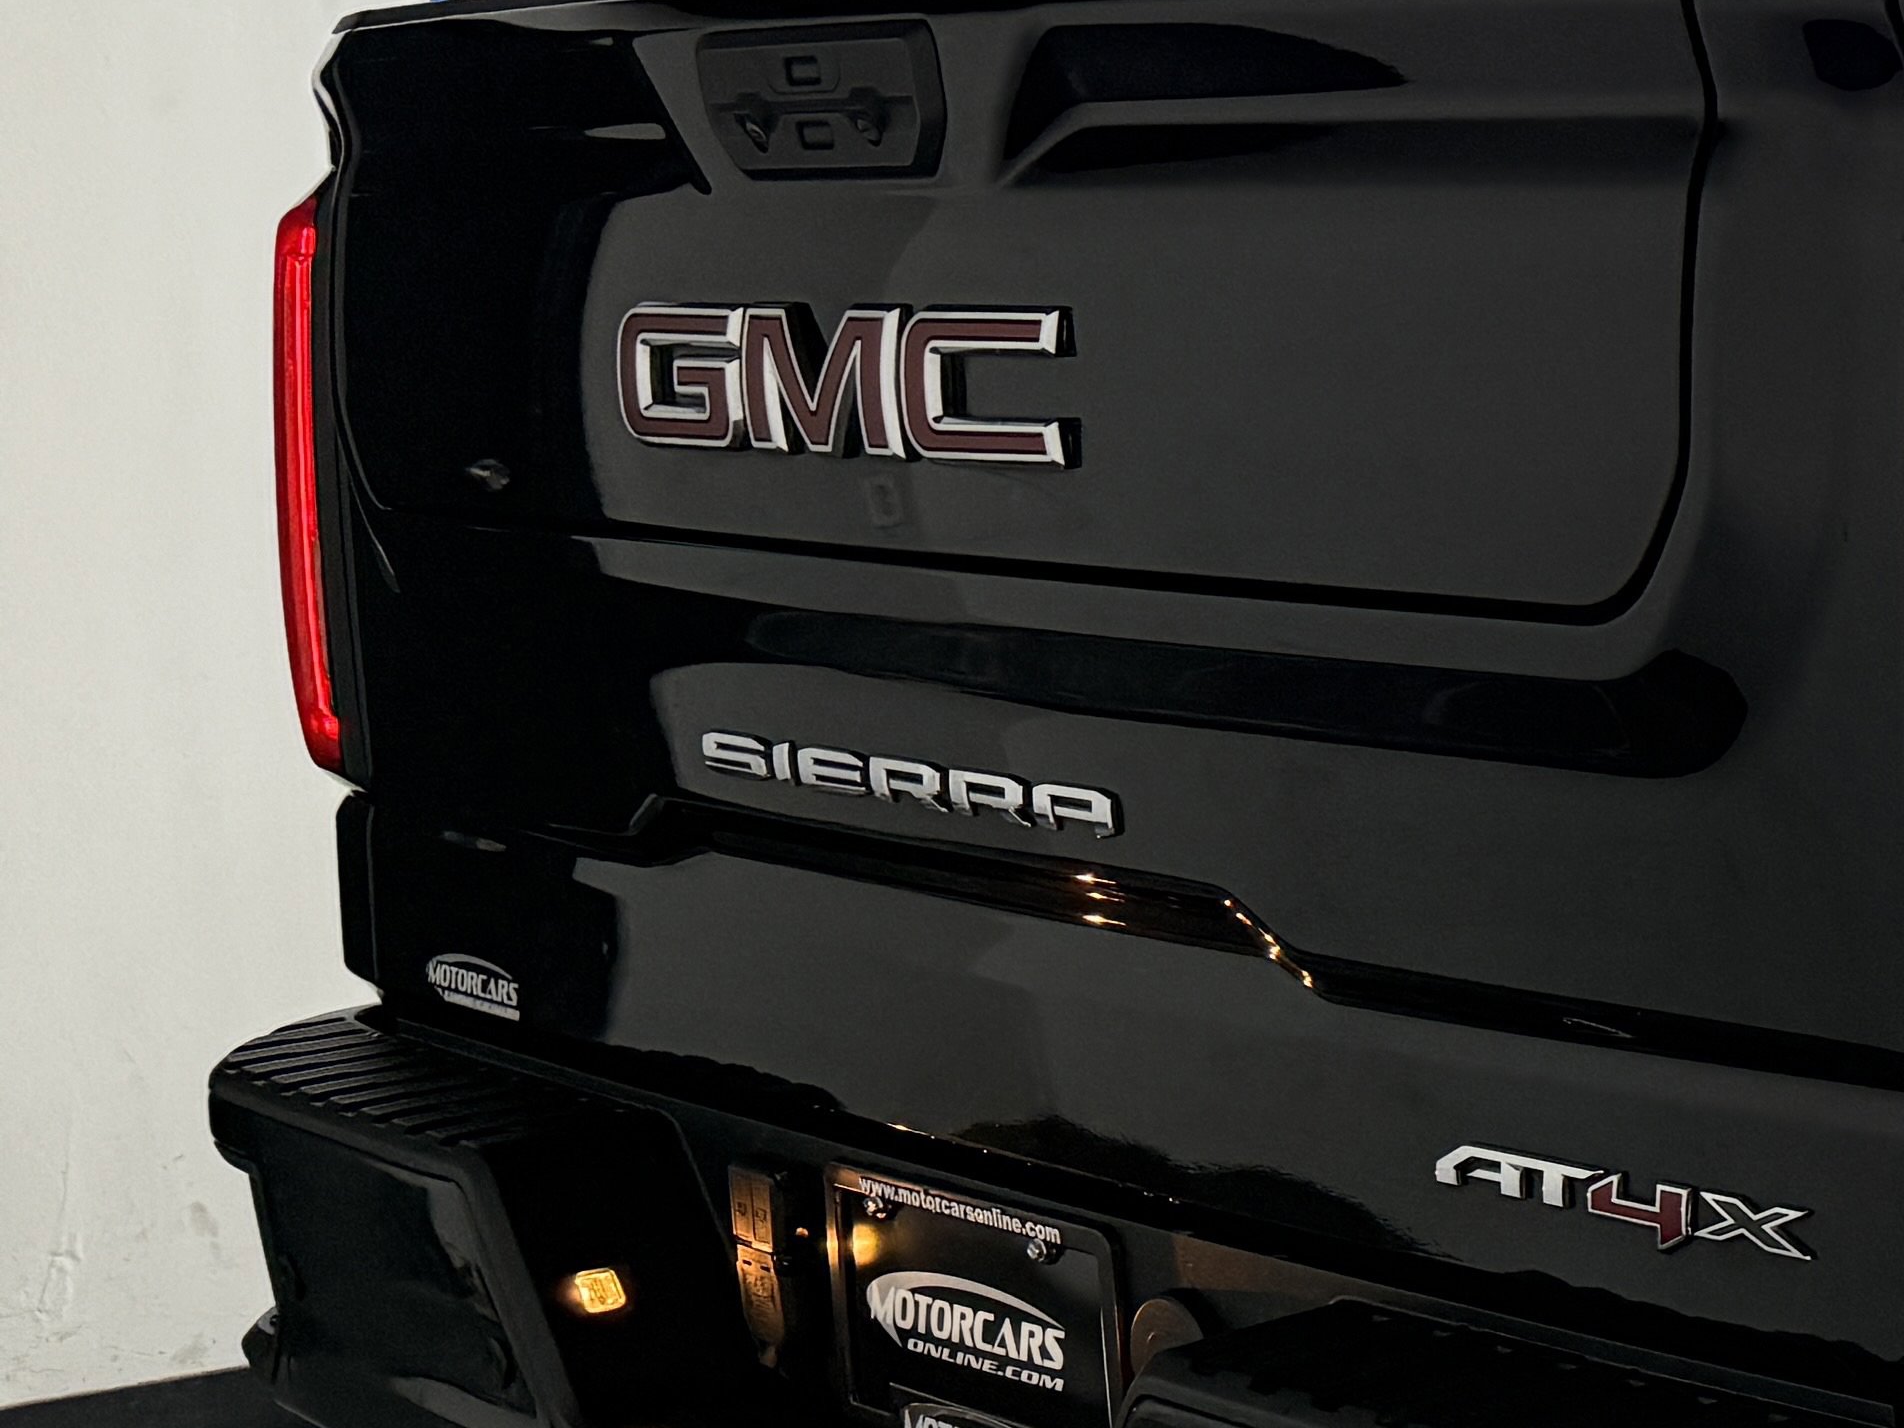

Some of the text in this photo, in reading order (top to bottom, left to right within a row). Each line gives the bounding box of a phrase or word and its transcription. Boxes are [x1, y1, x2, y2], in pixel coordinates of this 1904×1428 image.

[616, 302, 1081, 469] GMC
[701, 729, 1123, 838] SIERRA
[427, 959, 519, 1007] MOTORCARS
[859, 1176, 1061, 1244] www.motorcarsonline.com
[1434, 1144, 1815, 1260] AT4X
[870, 1281, 1065, 1370] MOTORCARS
[907, 1337, 1065, 1392] ONLINE.COM
